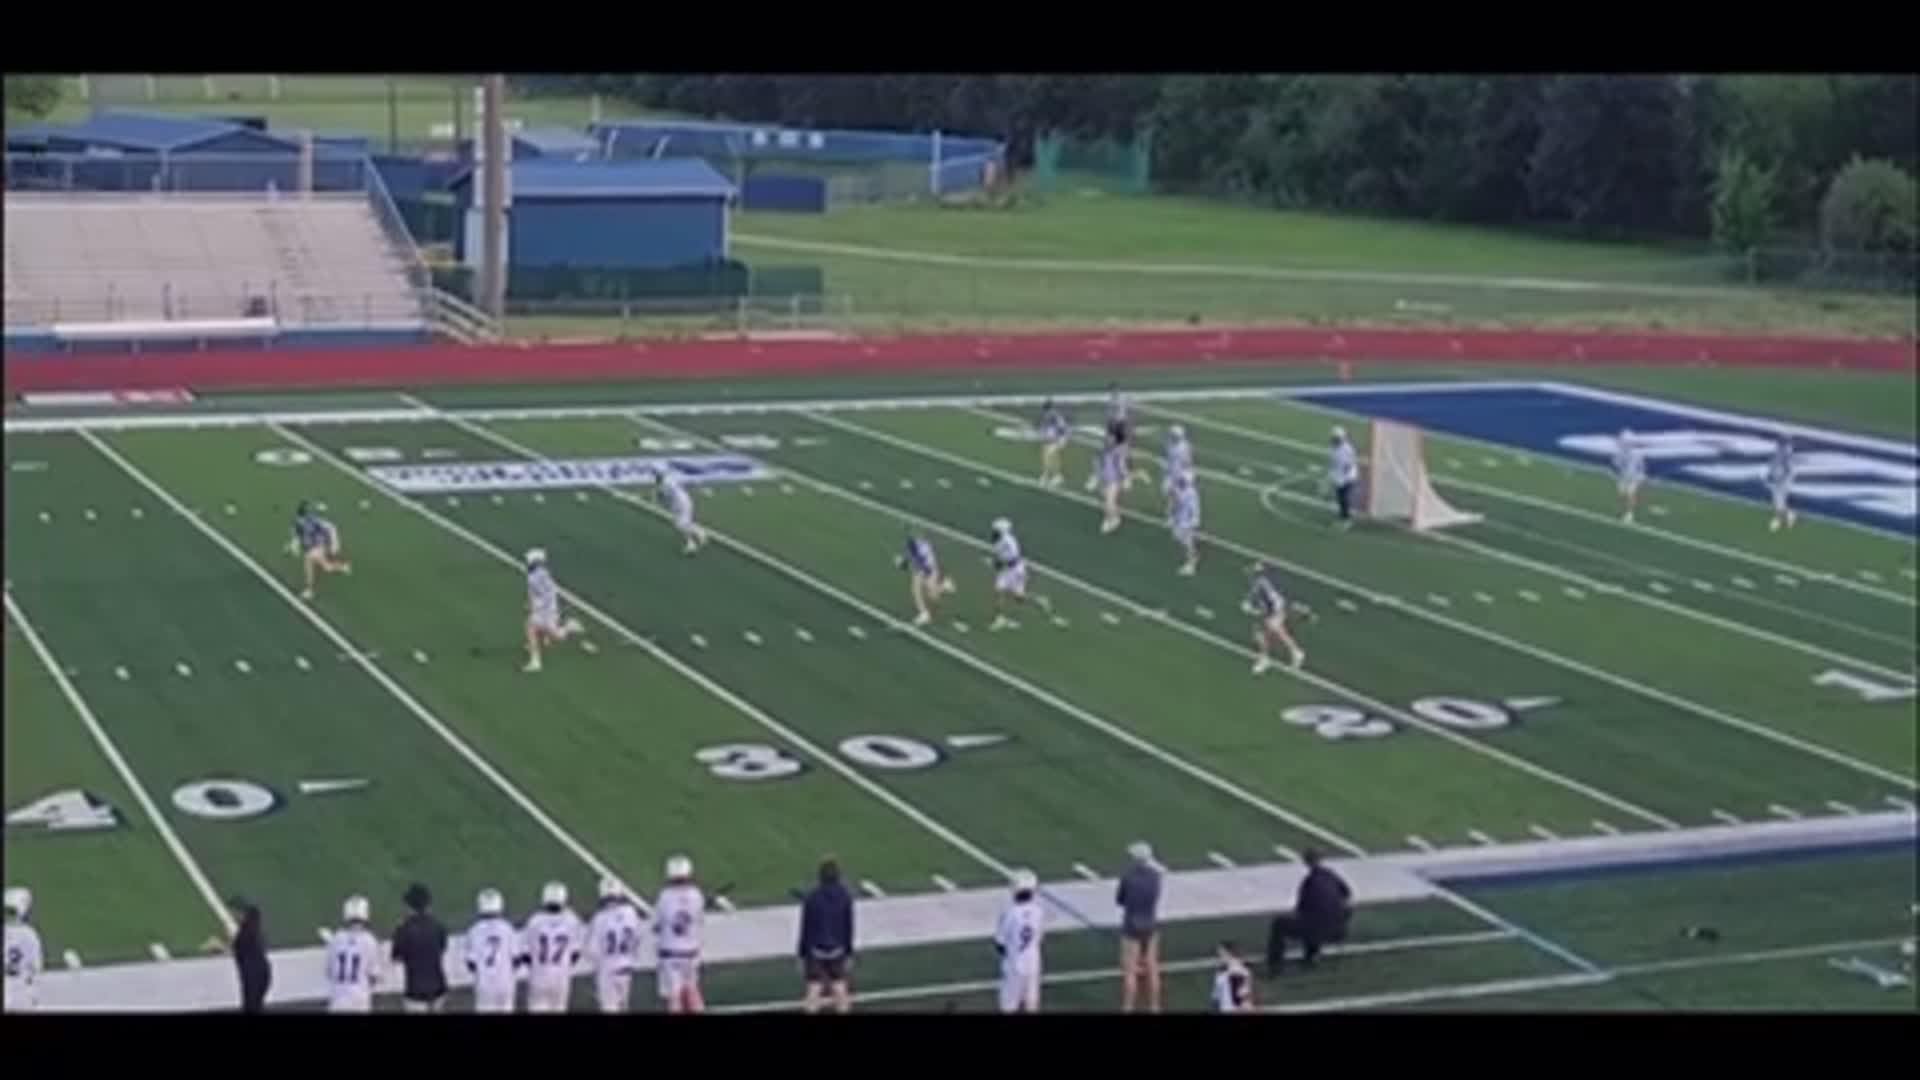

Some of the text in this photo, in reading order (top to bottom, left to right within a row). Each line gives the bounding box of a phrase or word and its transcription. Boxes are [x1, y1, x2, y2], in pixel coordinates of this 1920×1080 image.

[1280, 696, 1510, 739] 20
[694, 734, 940, 780] 30
[4, 779, 276, 829] 40
[337, 953, 361, 983] 11
[486, 935, 501, 967] 7
[538, 934, 569, 965] 17
